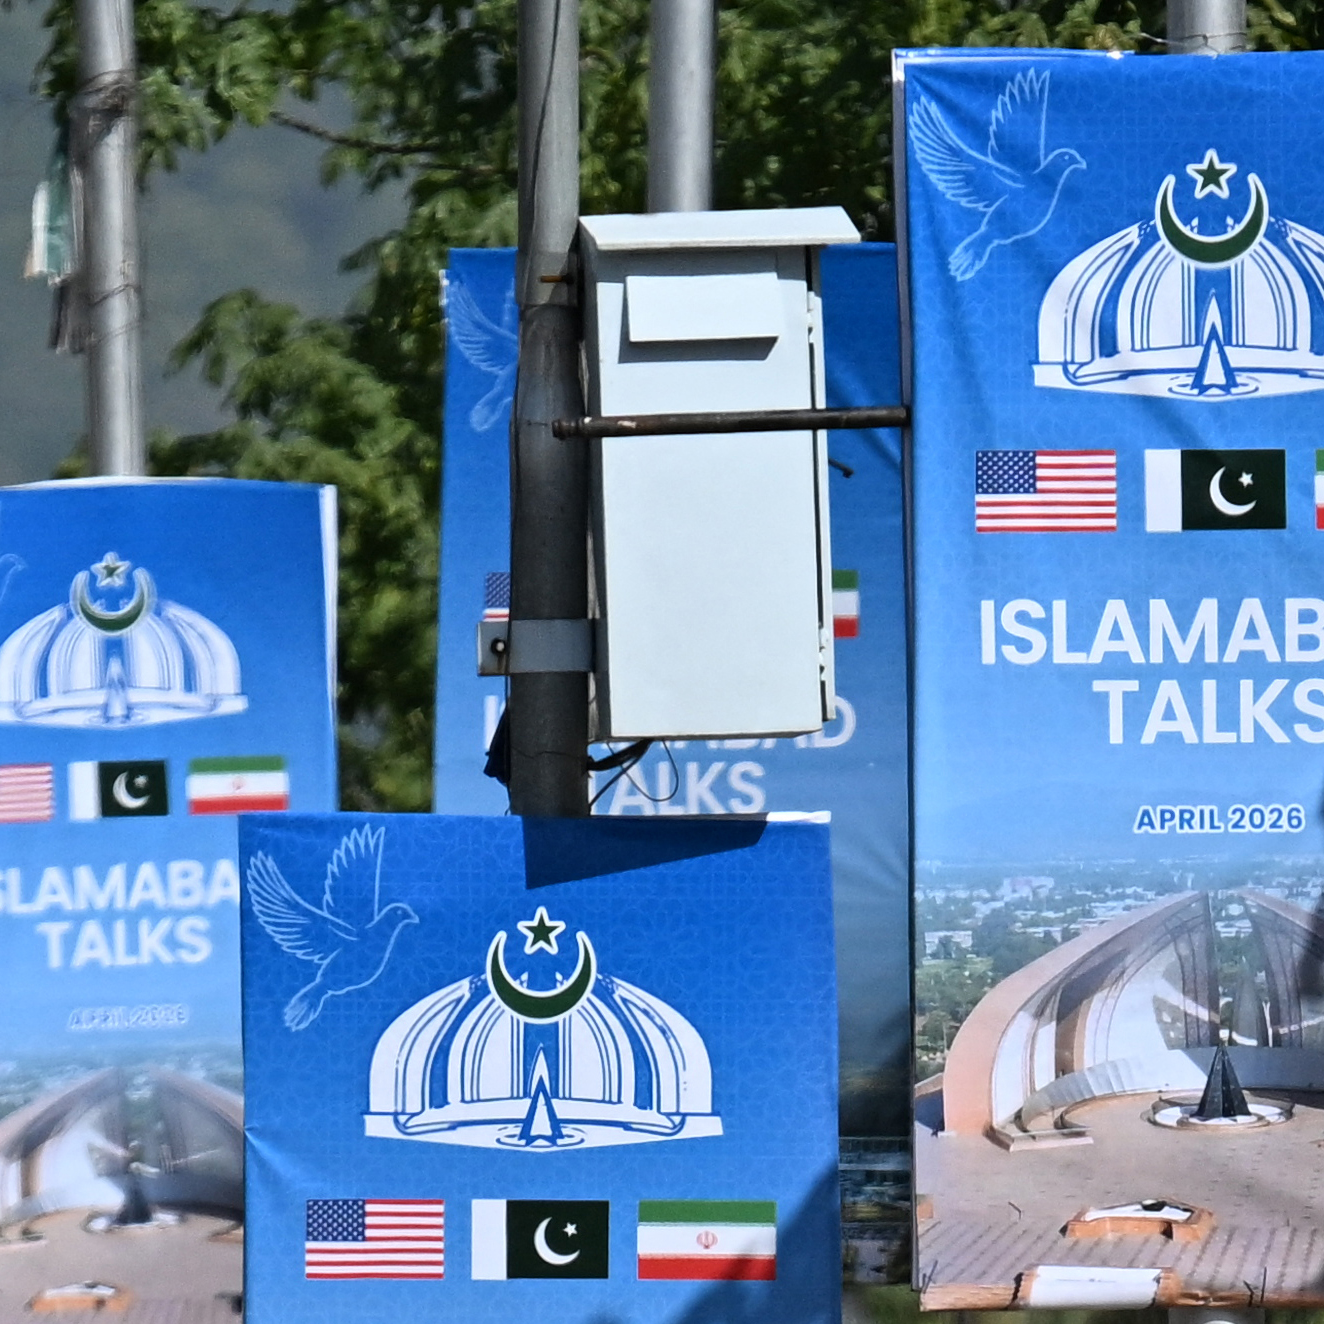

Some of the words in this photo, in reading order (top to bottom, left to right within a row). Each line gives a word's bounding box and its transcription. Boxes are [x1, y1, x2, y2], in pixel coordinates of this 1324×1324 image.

[589, 760, 766, 814] ALKS
[1133, 805, 1223, 834] APRIL
[1227, 803, 1305, 833] 2026
[36, 915, 213, 969] TALKS
